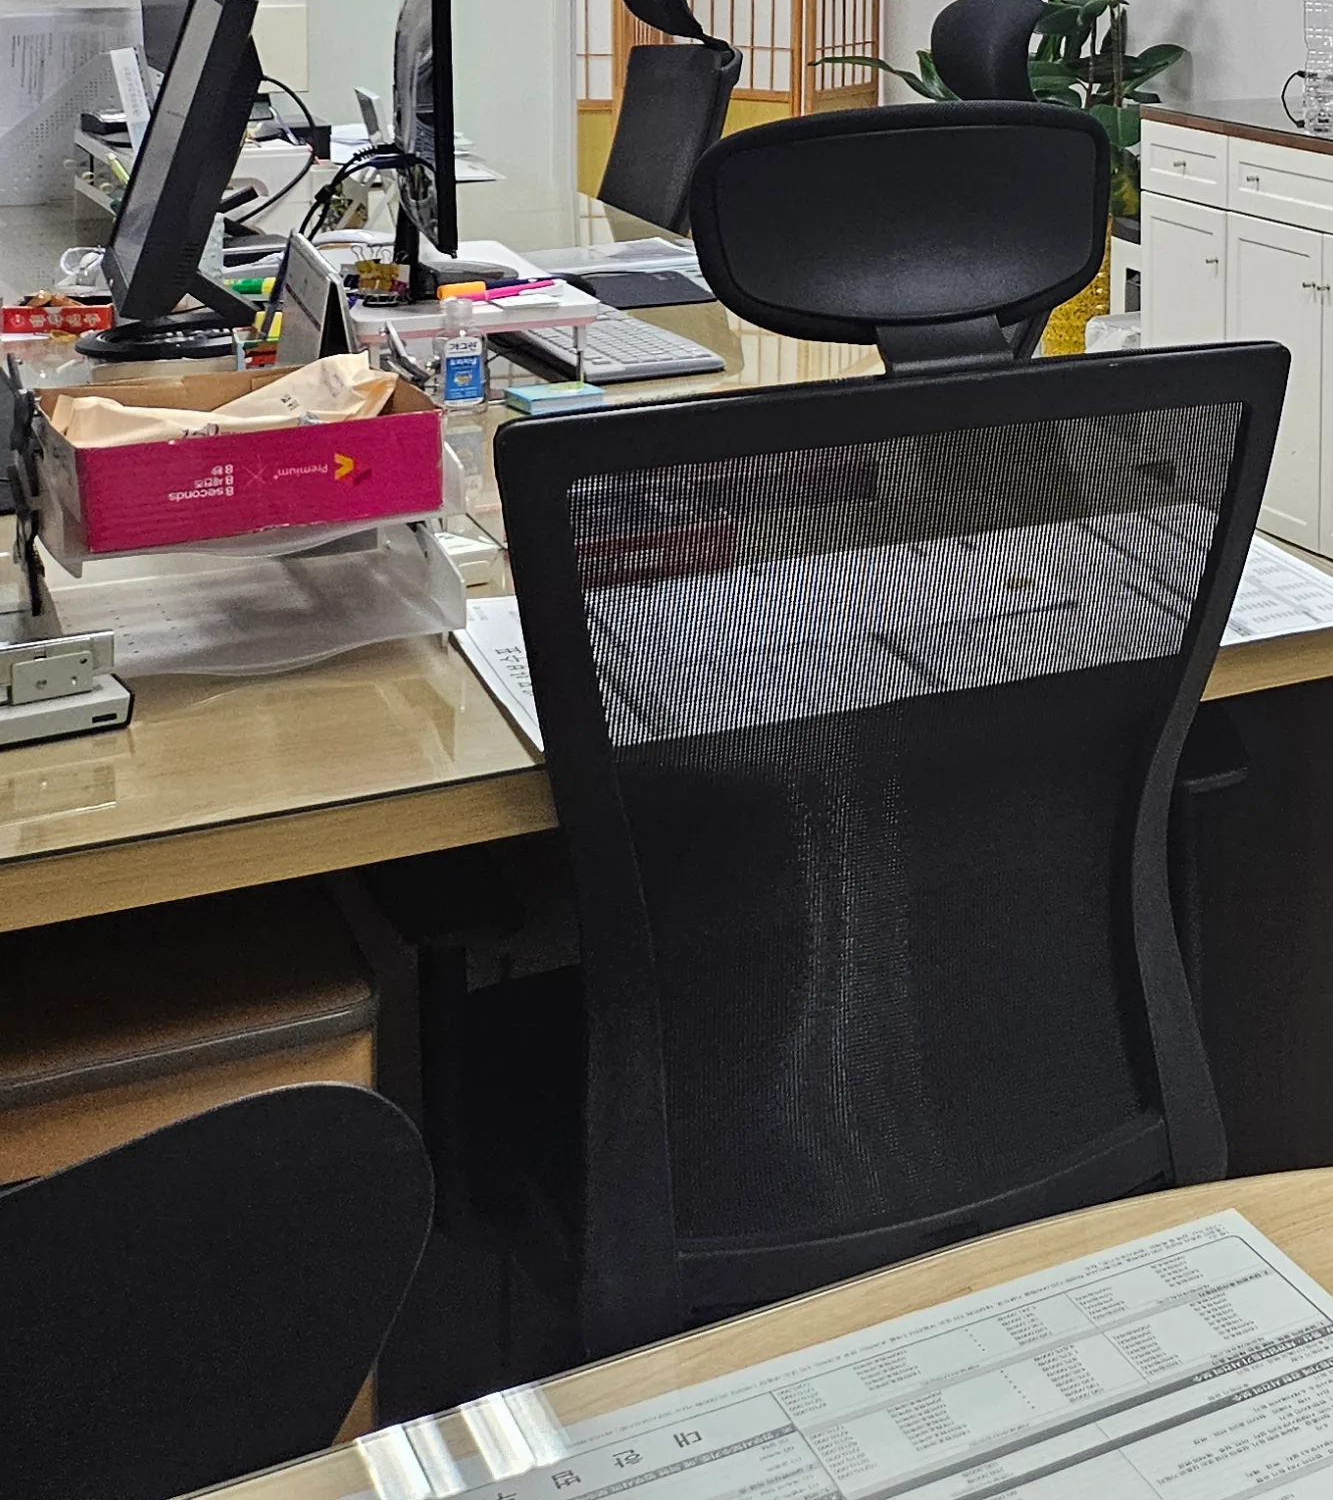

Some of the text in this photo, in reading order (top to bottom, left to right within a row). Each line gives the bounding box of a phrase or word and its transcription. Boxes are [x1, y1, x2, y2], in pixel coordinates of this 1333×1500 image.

[224, 464, 234, 475] 8
[225, 475, 234, 486] 8
[168, 486, 234, 502] 8 seconds
[670, 1426, 704, 1449] 대
[608, 1446, 646, 1470] 한
